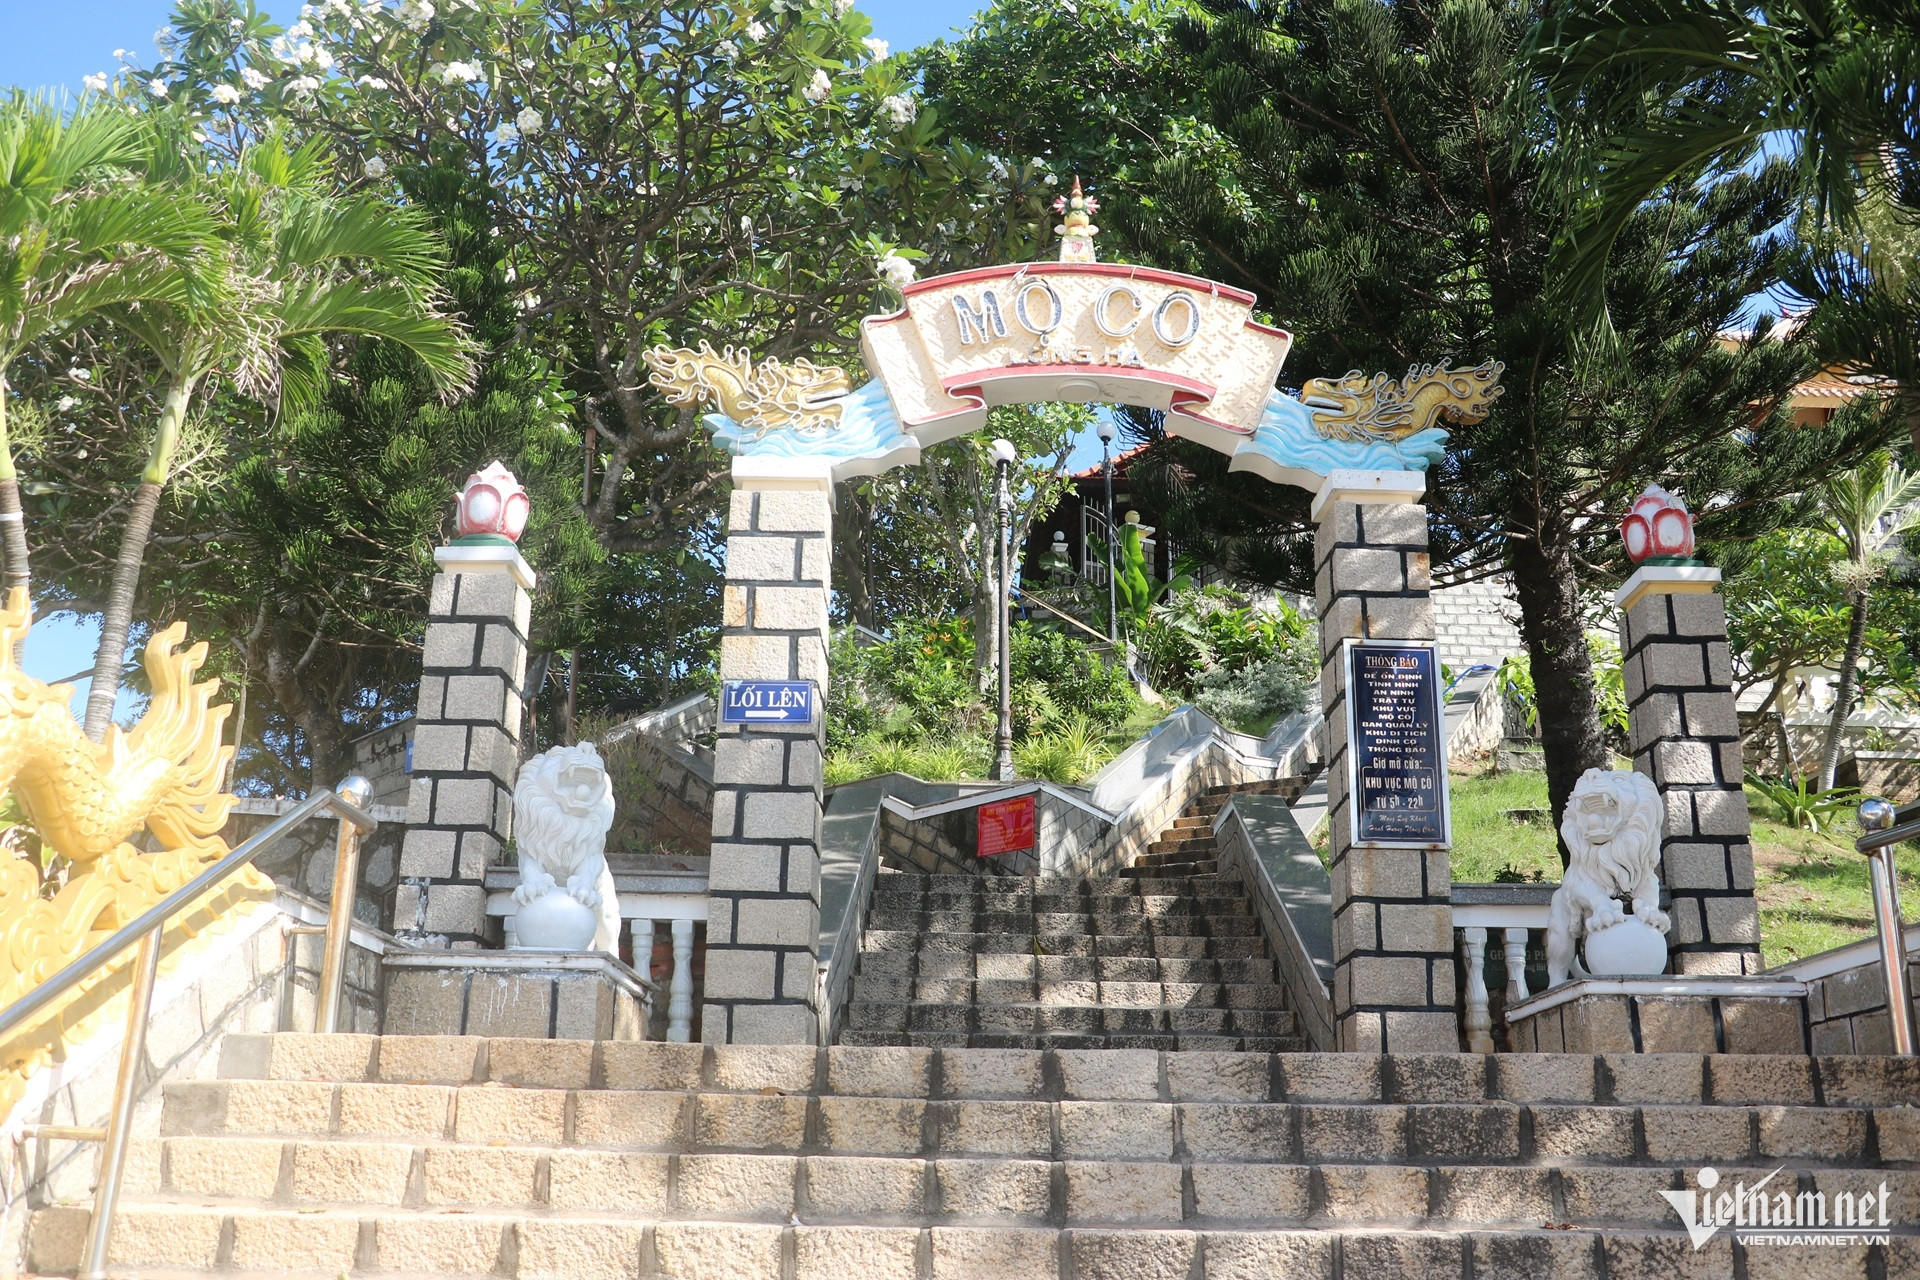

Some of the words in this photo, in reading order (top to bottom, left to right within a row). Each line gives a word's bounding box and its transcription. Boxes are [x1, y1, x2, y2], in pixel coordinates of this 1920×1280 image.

[1365, 653, 1398, 667] THÔNG
[1400, 653, 1419, 667] BÁO
[729, 685, 763, 708] LỐI
[767, 686, 807, 708] LÊN
[1389, 756, 1401, 769] mở
[1365, 776, 1382, 789] KHU
[1384, 776, 1401, 791] VỰC
[1403, 775, 1418, 792] MỘ
[1420, 775, 1432, 789] CÔ
